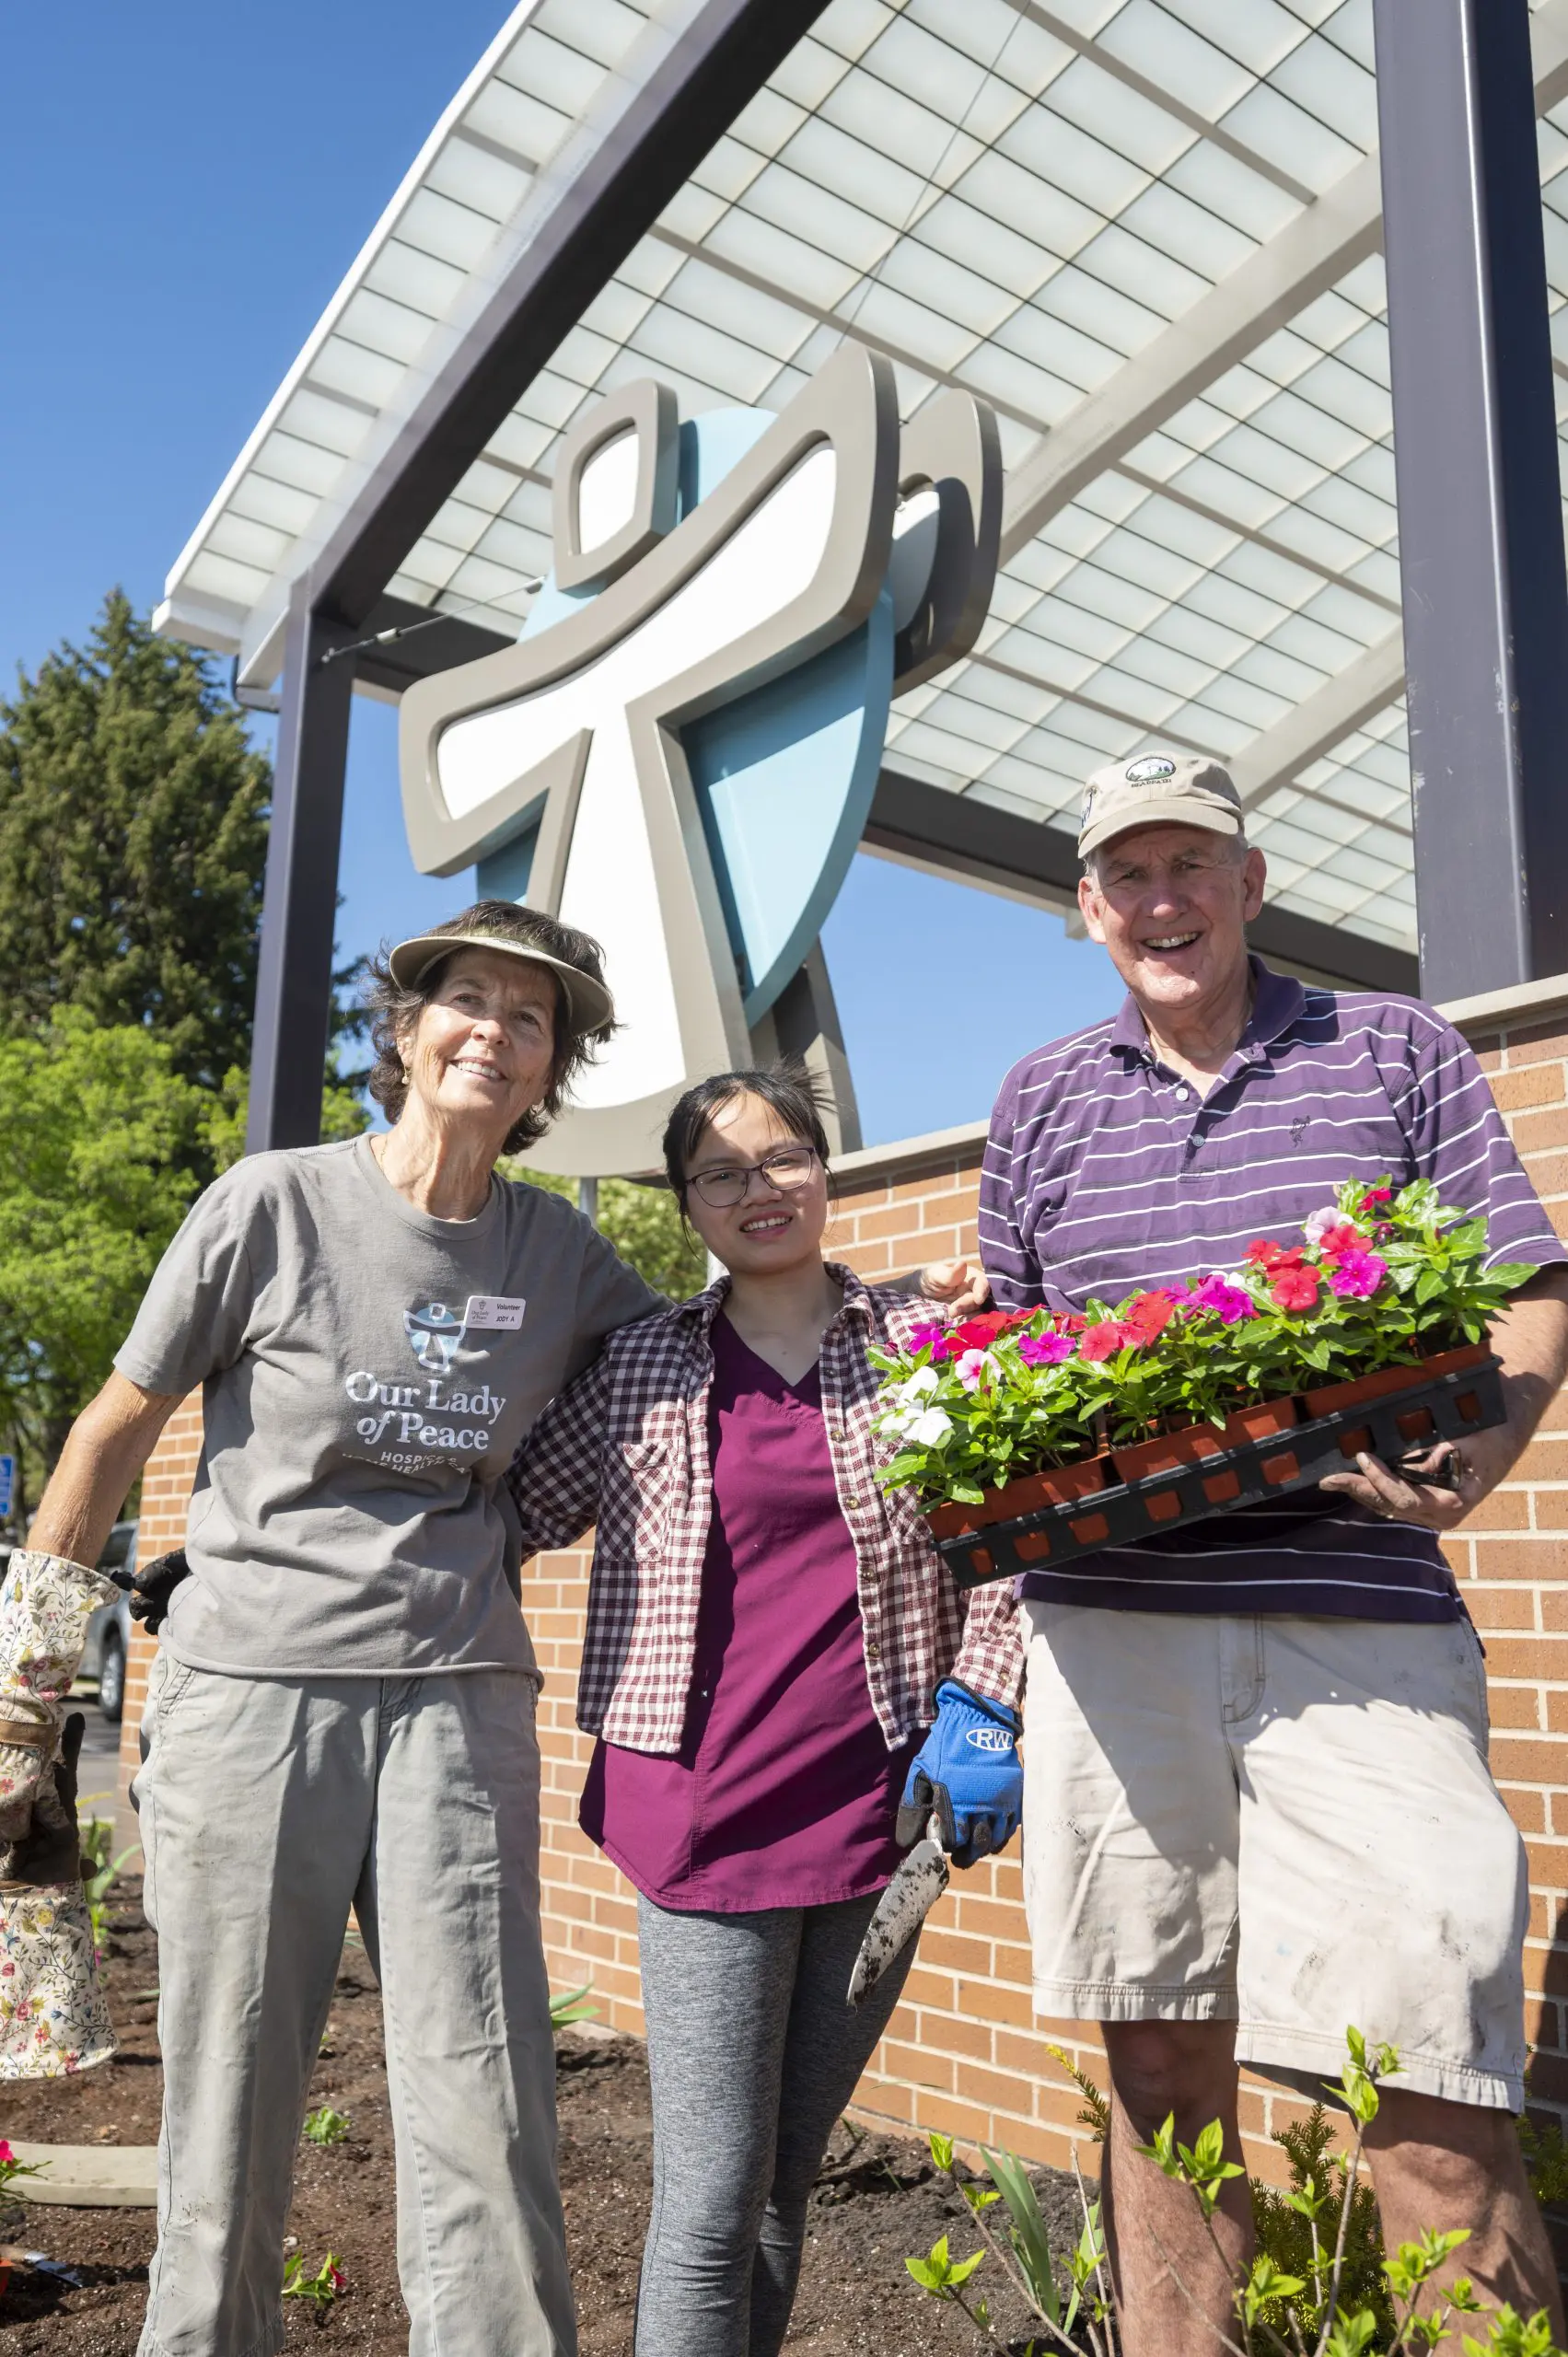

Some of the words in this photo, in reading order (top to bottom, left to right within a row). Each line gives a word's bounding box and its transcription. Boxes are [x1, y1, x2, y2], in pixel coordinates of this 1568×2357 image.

[496, 1303, 521, 1311] Volunteer
[345, 1371, 421, 1408] Our
[424, 1379, 506, 1425] Lady
[356, 1410, 397, 1446] of
[396, 1411, 490, 1451] Peace
[380, 1451, 445, 1465] HOSPICE
